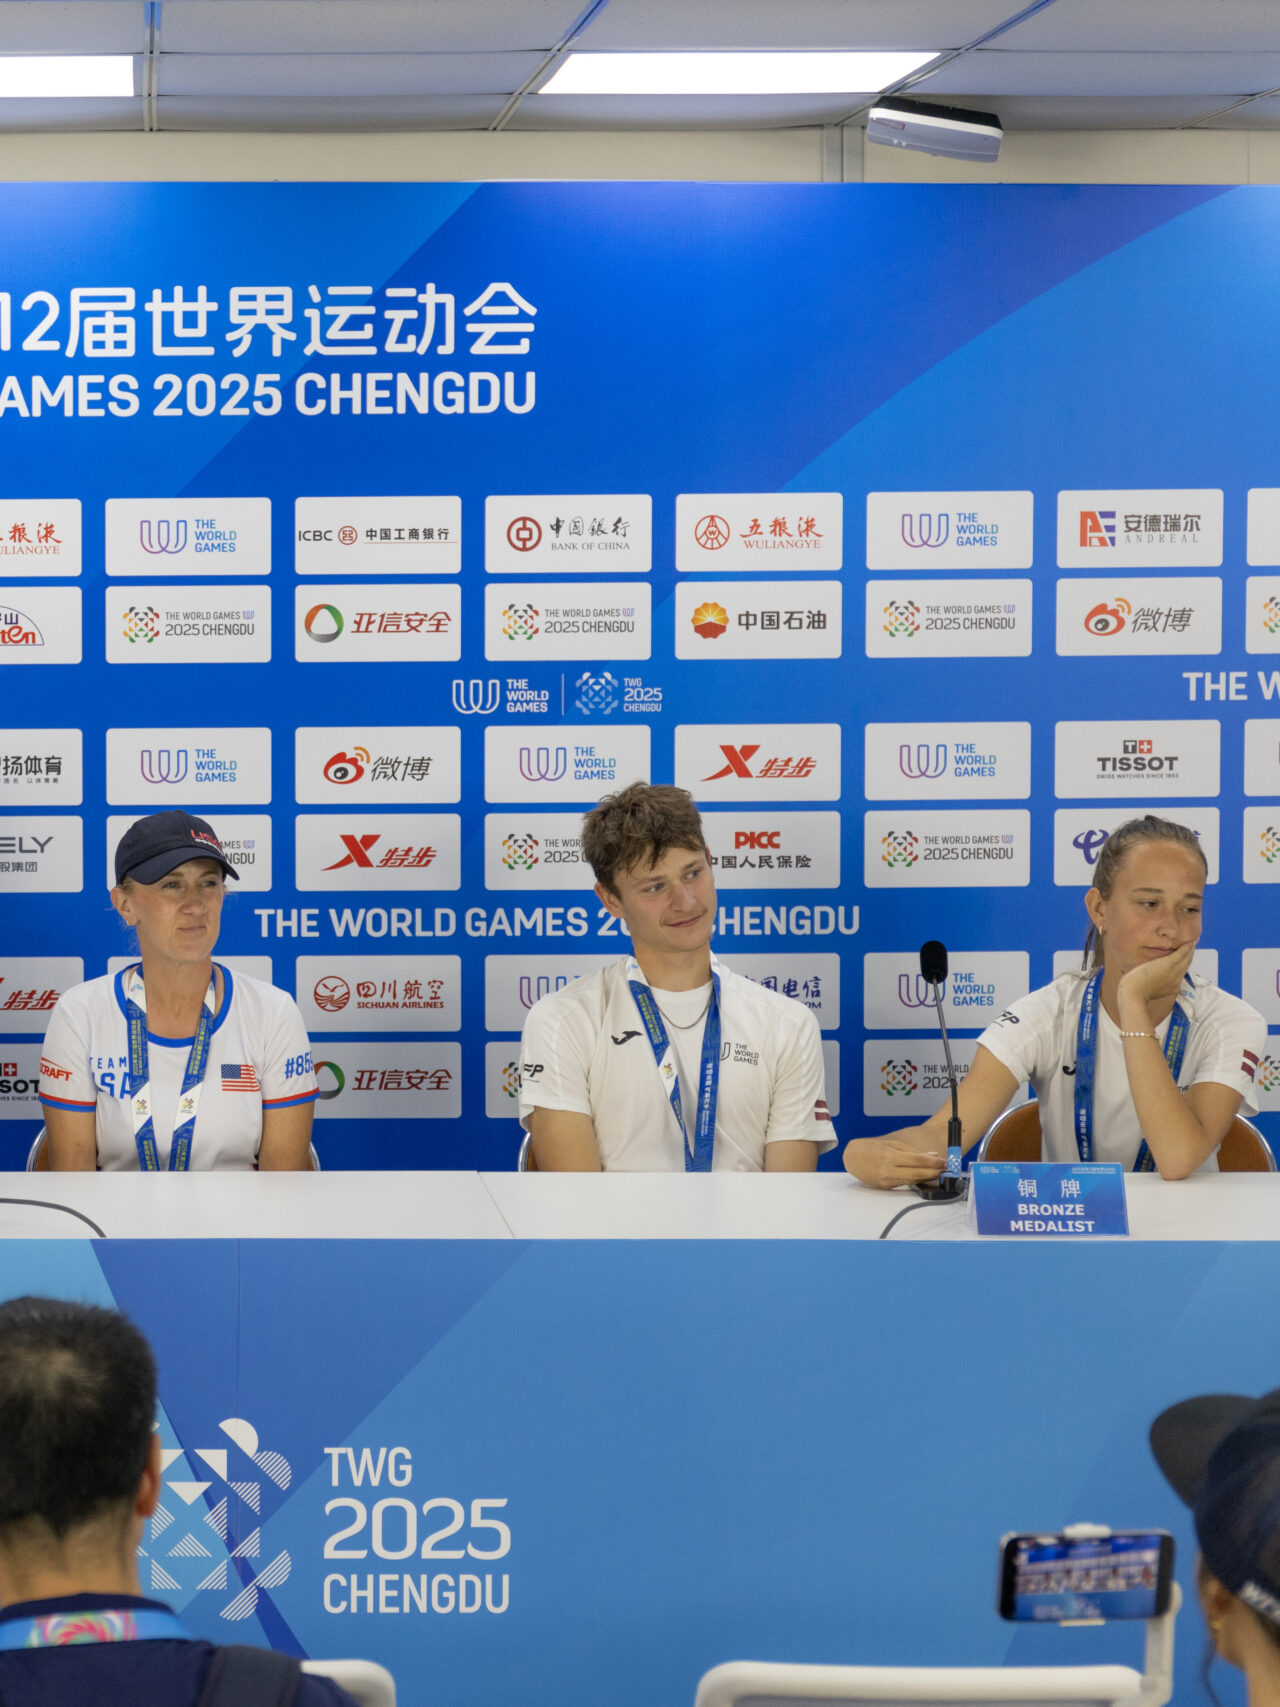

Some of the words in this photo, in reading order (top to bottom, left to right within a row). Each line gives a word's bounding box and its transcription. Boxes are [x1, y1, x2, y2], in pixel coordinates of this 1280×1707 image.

[153, 373, 282, 416] 2025
[296, 371, 535, 415] CHENGDU
[957, 513, 978, 522] THE
[1124, 514, 1200, 532] 安德瑞尔
[366, 528, 449, 540] 中国工商银行
[957, 524, 998, 534] WORLD
[299, 530, 332, 541] ICBC
[957, 536, 997, 546] GAMES
[1125, 533, 1198, 543] ANDREAL
[598, 542, 630, 550] CHINA
[744, 540, 820, 549] WULIANGYE
[545, 609, 559, 617] THE
[562, 609, 591, 617] WORLD
[593, 609, 620, 617] GAMES
[351, 612, 451, 633] 亚信安全
[738, 610, 826, 630] 中国石油
[926, 618, 961, 630] 2025
[963, 618, 1015, 629] CHENGDU
[1132, 607, 1194, 633] 微博
[165, 624, 200, 636] 2025
[202, 624, 254, 635] CHENGDU
[545, 621, 580, 633] 2025
[582, 621, 634, 633] CHENGDU
[507, 679, 528, 689] THE
[624, 678, 642, 687] TWG
[1183, 672, 1247, 701] THE
[506, 691, 549, 701] WORLD
[624, 688, 662, 701] 2025
[507, 702, 547, 712] GAMES
[623, 703, 661, 712] CHENGDU
[575, 747, 595, 756] THE
[371, 756, 432, 781] 微博
[574, 758, 616, 768] WORLD
[1097, 757, 1178, 771] TISSOT
[574, 770, 615, 780] GAMES
[735, 831, 780, 849] PICC
[544, 851, 579, 863] 2025
[254, 909, 319, 937] THE
[329, 908, 456, 937] WORLD
[465, 907, 588, 937] GAMES
[953, 973, 974, 983] THE
[357, 980, 444, 1000] 四川航空
[953, 984, 995, 994] WORLD
[953, 996, 993, 1006] GAMES
[735, 1050, 759, 1059] WORLD
[734, 1056, 758, 1066] GAMES
[352, 1069, 452, 1090] 亚信安全
[1017, 1179, 1037, 1198] 铜
[1061, 1179, 1081, 1198] 牌
[1018, 1204, 1085, 1215] BRONZE
[1011, 1221, 1095, 1232] MEDALIST
[324, 1447, 412, 1487] TWG
[324, 1498, 511, 1560] 2025
[324, 1574, 509, 1613] CHENGDU
